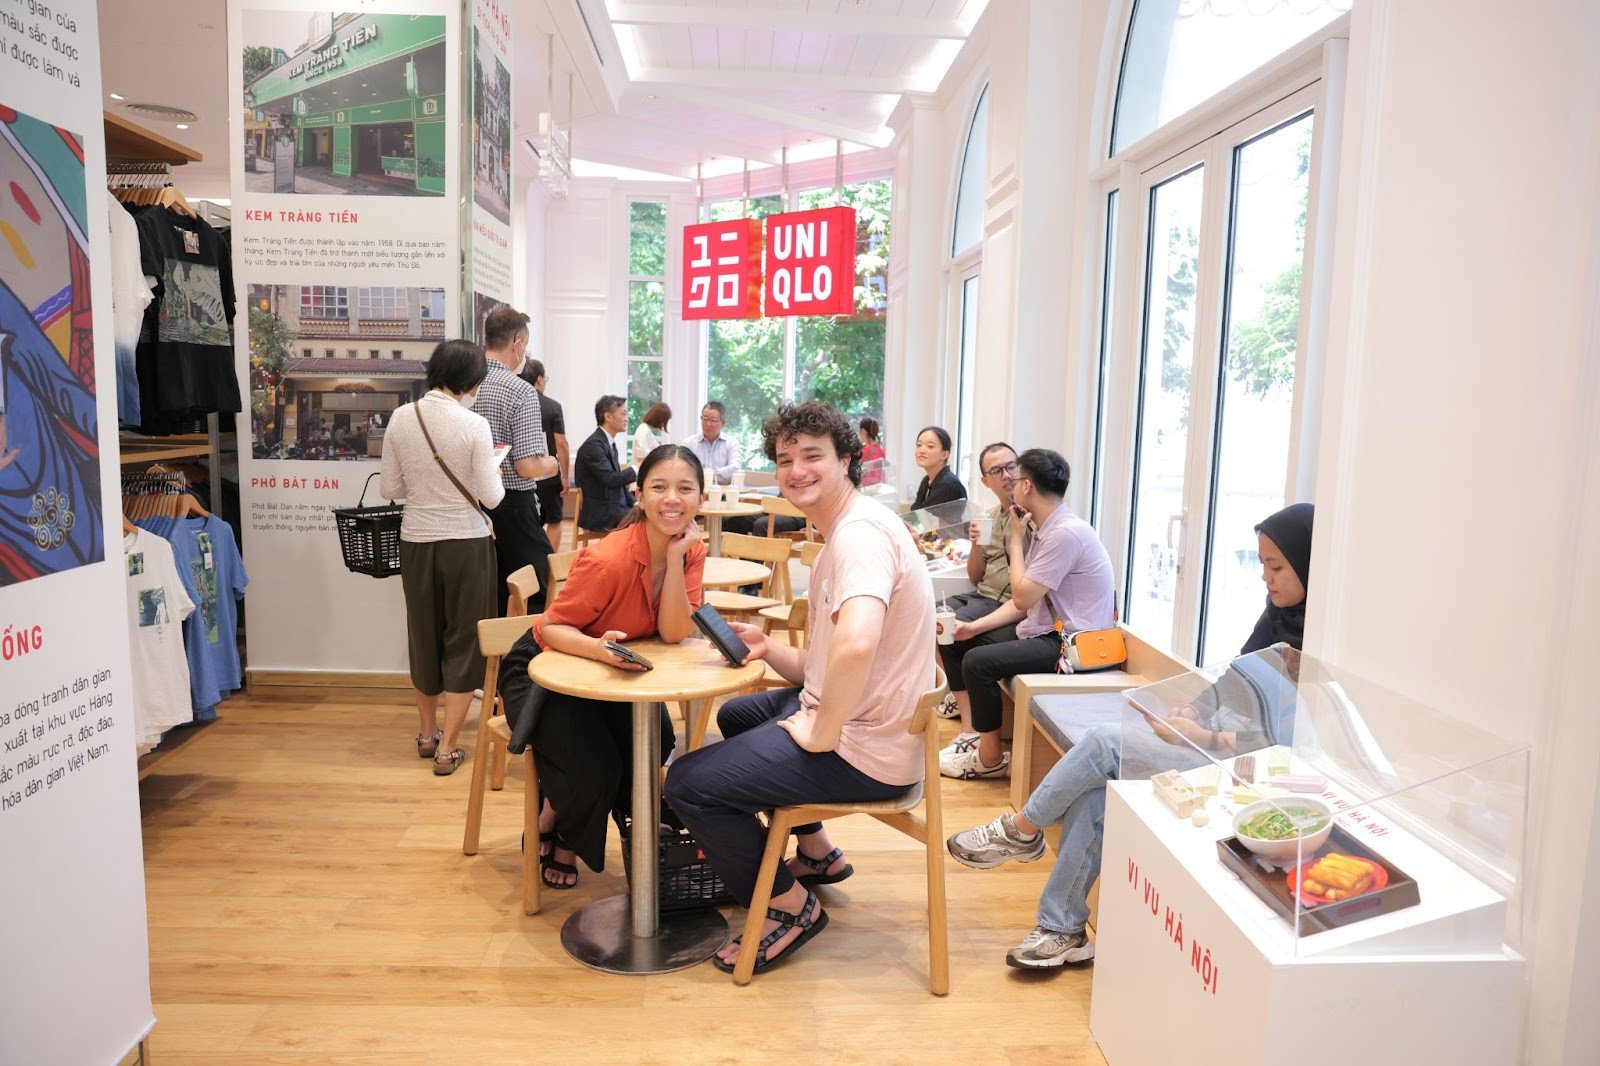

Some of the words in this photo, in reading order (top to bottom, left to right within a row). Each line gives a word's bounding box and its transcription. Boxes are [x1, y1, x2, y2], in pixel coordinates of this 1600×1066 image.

[28, 23, 47, 45] sắc
[51, 36, 78, 61] được
[56, 13, 76, 33] của
[11, 43, 38, 70] được
[42, 56, 63, 81] làm
[68, 72, 80, 88] và
[245, 210, 272, 222] KEM
[279, 209, 322, 222] TRÀNG
[243, 236, 260, 244] Kem
[418, 240, 429, 248] bao
[266, 248, 282, 256] Kem
[691, 232, 739, 269] ユニ
[773, 220, 828, 261] UNI
[688, 273, 739, 309] クロ
[772, 264, 832, 310] QLO
[283, 476, 307, 489] BÁT
[313, 476, 340, 489] ĐÀN
[2, 624, 43, 661] ỐNG
[14, 700, 39, 720] dòng
[42, 684, 69, 707] tranh
[72, 677, 89, 694] dân
[92, 669, 111, 689] gian
[4, 728, 28, 754] xuất
[32, 720, 45, 740] tại
[48, 713, 66, 733] khu
[69, 704, 86, 722] vực
[89, 692, 113, 713] Hàng
[0, 765, 13, 784] ắc
[17, 753, 40, 775] màu
[43, 743, 60, 762] rực
[78, 725, 94, 743] độc
[2, 790, 22, 812] hóa
[24, 778, 43, 798] dân
[46, 768, 66, 789] gian
[68, 751, 85, 772] Việt
[1128, 857, 1138, 890] VI
[1144, 876, 1159, 916] VU
[1165, 905, 1183, 952] HÀ
[1191, 939, 1218, 996] NỘI
